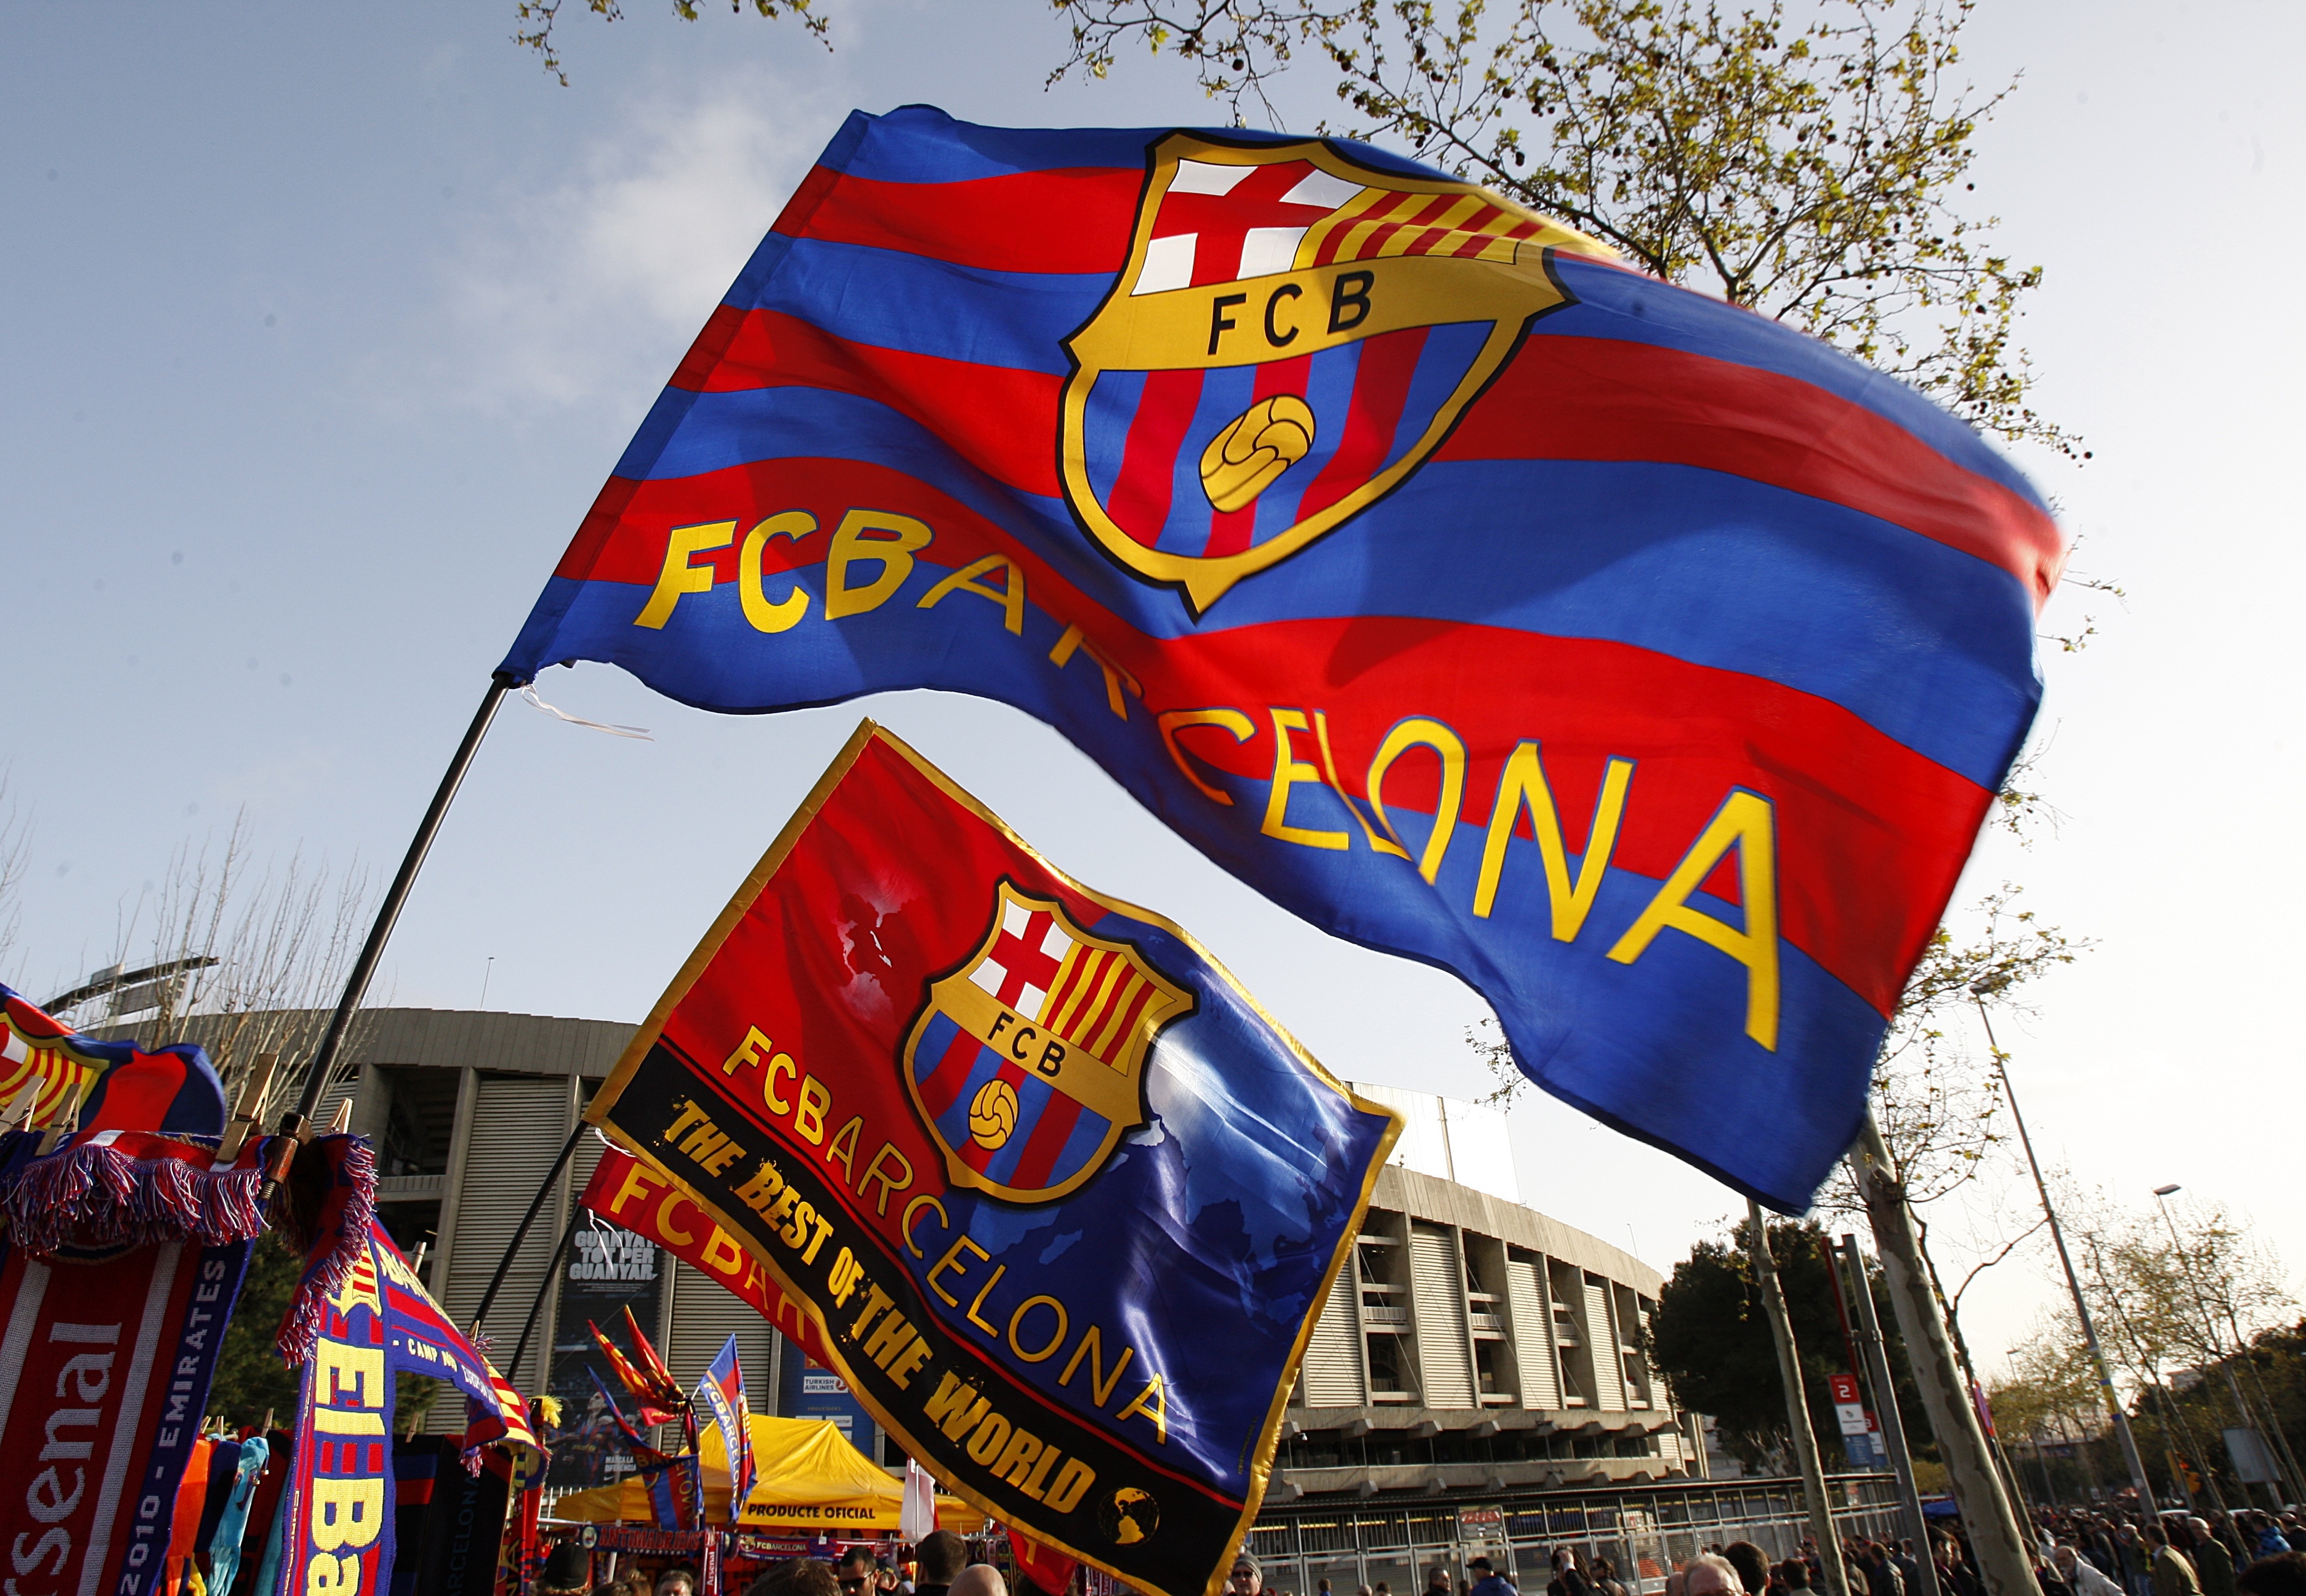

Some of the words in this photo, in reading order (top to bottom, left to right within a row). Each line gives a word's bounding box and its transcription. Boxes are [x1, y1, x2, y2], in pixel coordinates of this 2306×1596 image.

[1207, 270, 1375, 356] FCB
[987, 1012, 1067, 1078] FCB
[722, 1025, 1167, 1445] FCBARCELONA
[581, 1247, 616, 1263] TOT
[619, 1247, 655, 1264] PER
[663, 1099, 748, 1177] THE
[733, 1161, 834, 1266] BEST
[828, 1246, 864, 1309] OF
[852, 1283, 933, 1390] THE
[923, 1370, 1097, 1514] WORLD
[158, 1259, 227, 1448] EMIRATES
[407, 1337, 438, 1363] CAMP
[1839, 1385, 1851, 1398] 2
[748, 1504, 820, 1518] PRODUCTE
[824, 1506, 876, 1520] OFICIAL
[756, 1542, 807, 1552] FCBARCELONA
[706, 1551, 716, 1587] Arsenal
